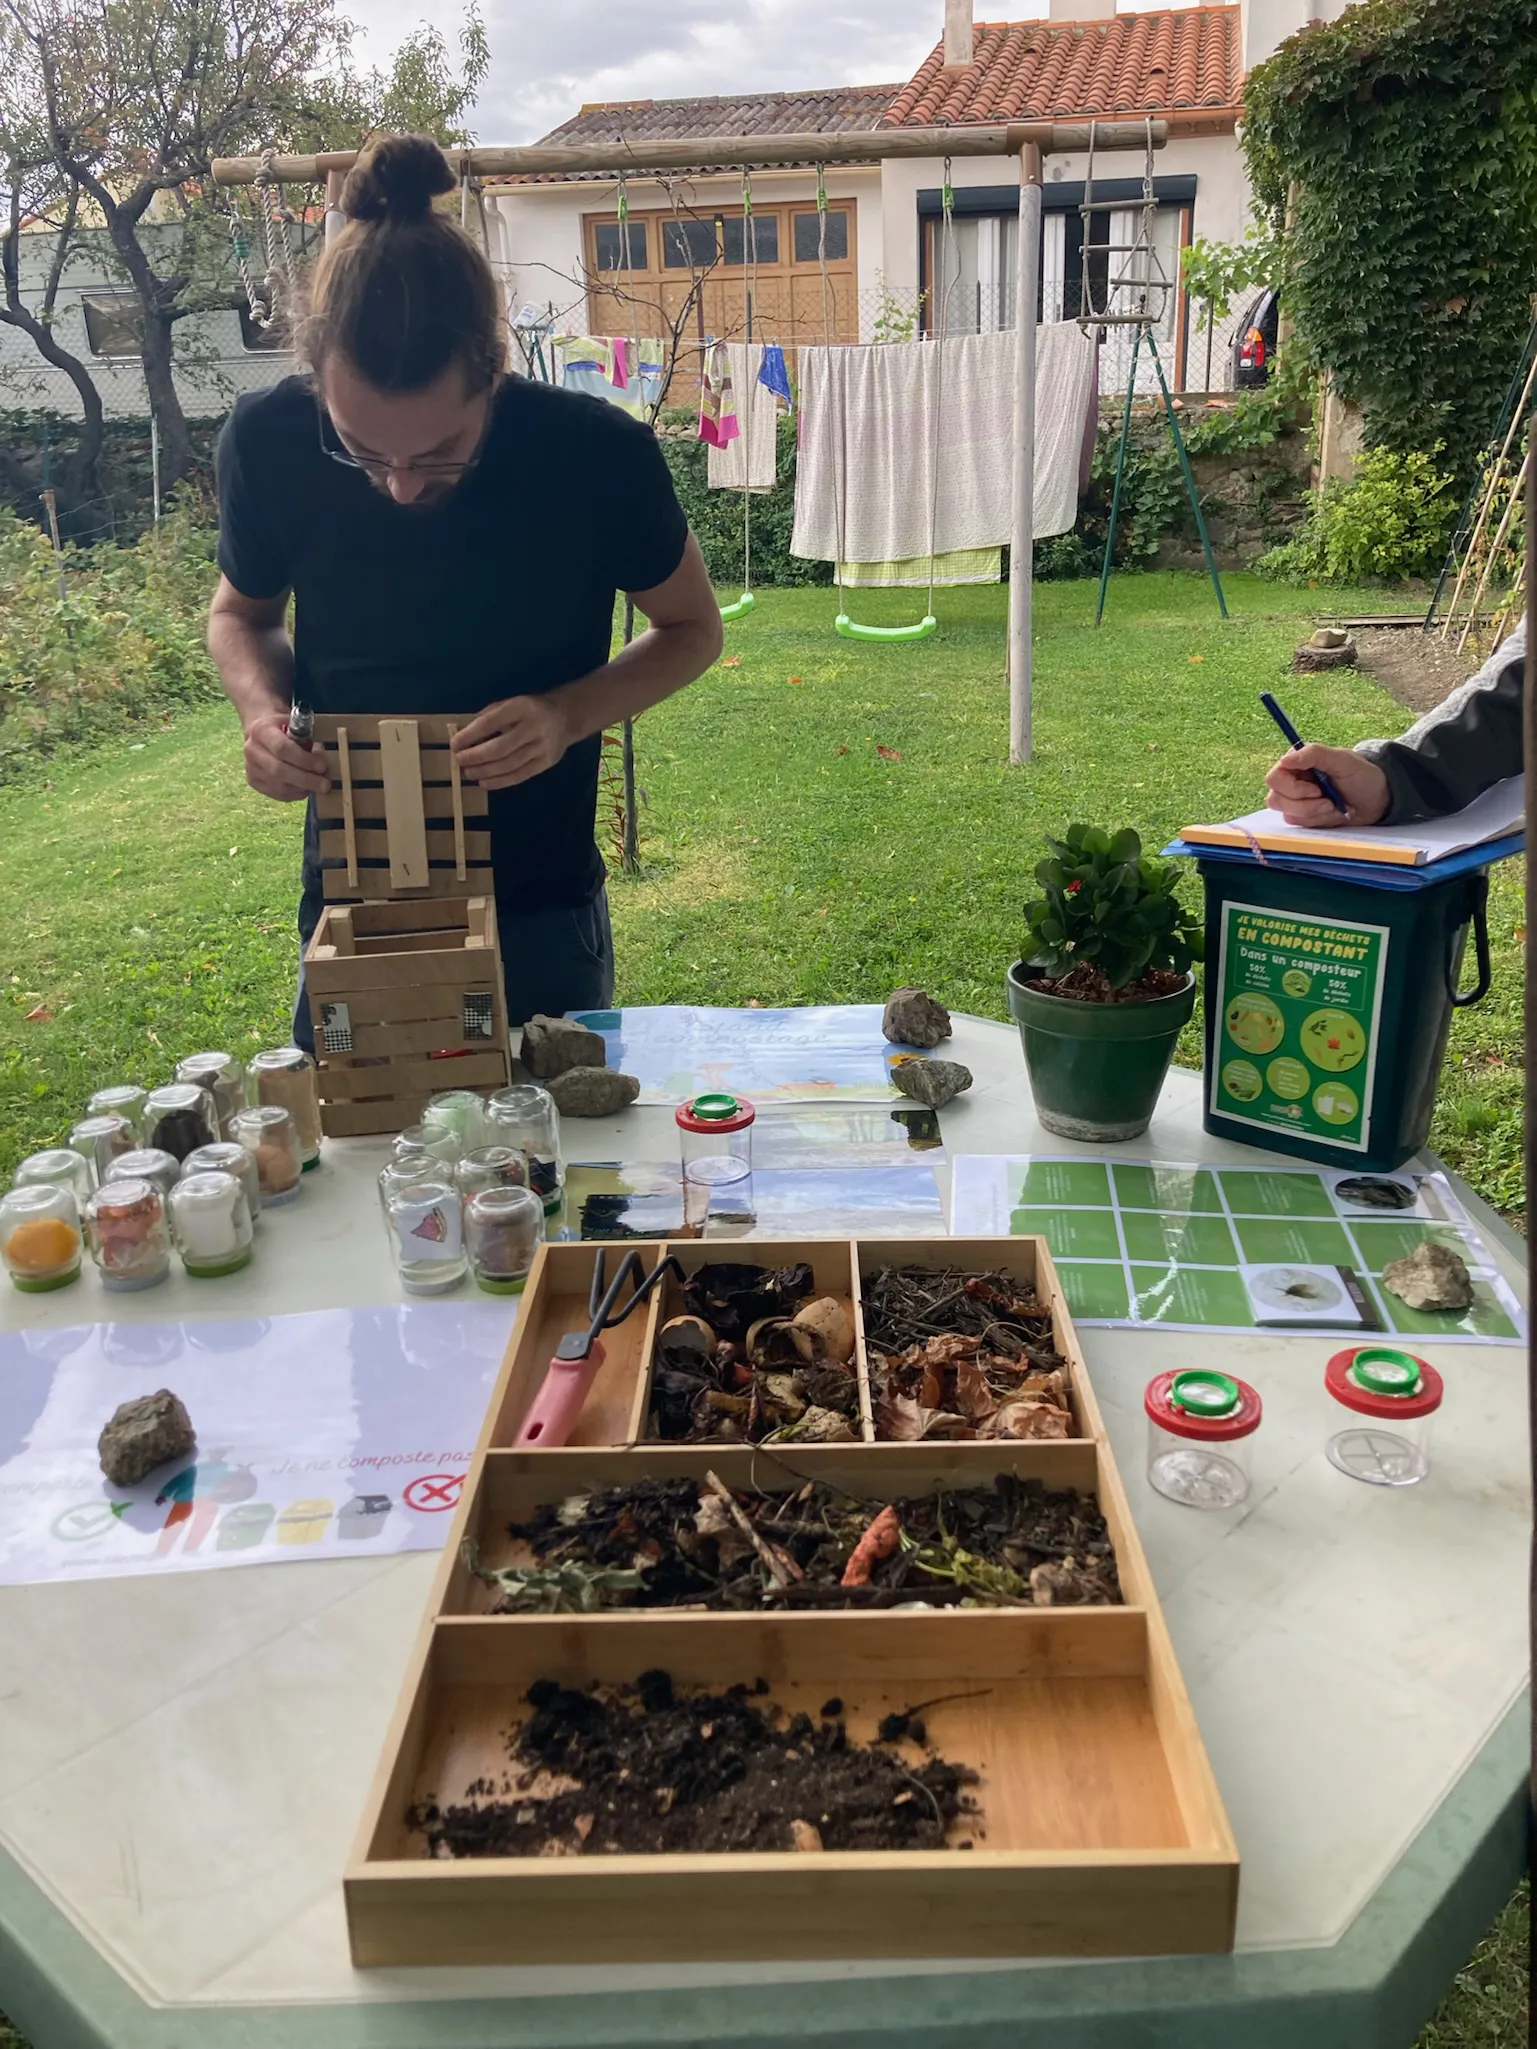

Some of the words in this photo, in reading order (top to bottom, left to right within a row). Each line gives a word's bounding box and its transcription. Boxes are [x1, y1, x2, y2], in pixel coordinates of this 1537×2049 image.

[1237, 915, 1249, 925] JE
[1252, 917, 1297, 933] VALORISE
[1299, 925, 1321, 937] MES
[1323, 928, 1371, 945] DÉCHETS
[1237, 927, 1258, 942] EN
[1262, 931, 1368, 960] COMPOSTANT
[1240, 946, 1267, 961] Dans
[1272, 954, 1286, 965] un
[1291, 958, 1362, 978] composteur
[1249, 963, 1266, 974] 50%
[1328, 979, 1348, 990] 50%
[337, 1450, 436, 1471] composte
